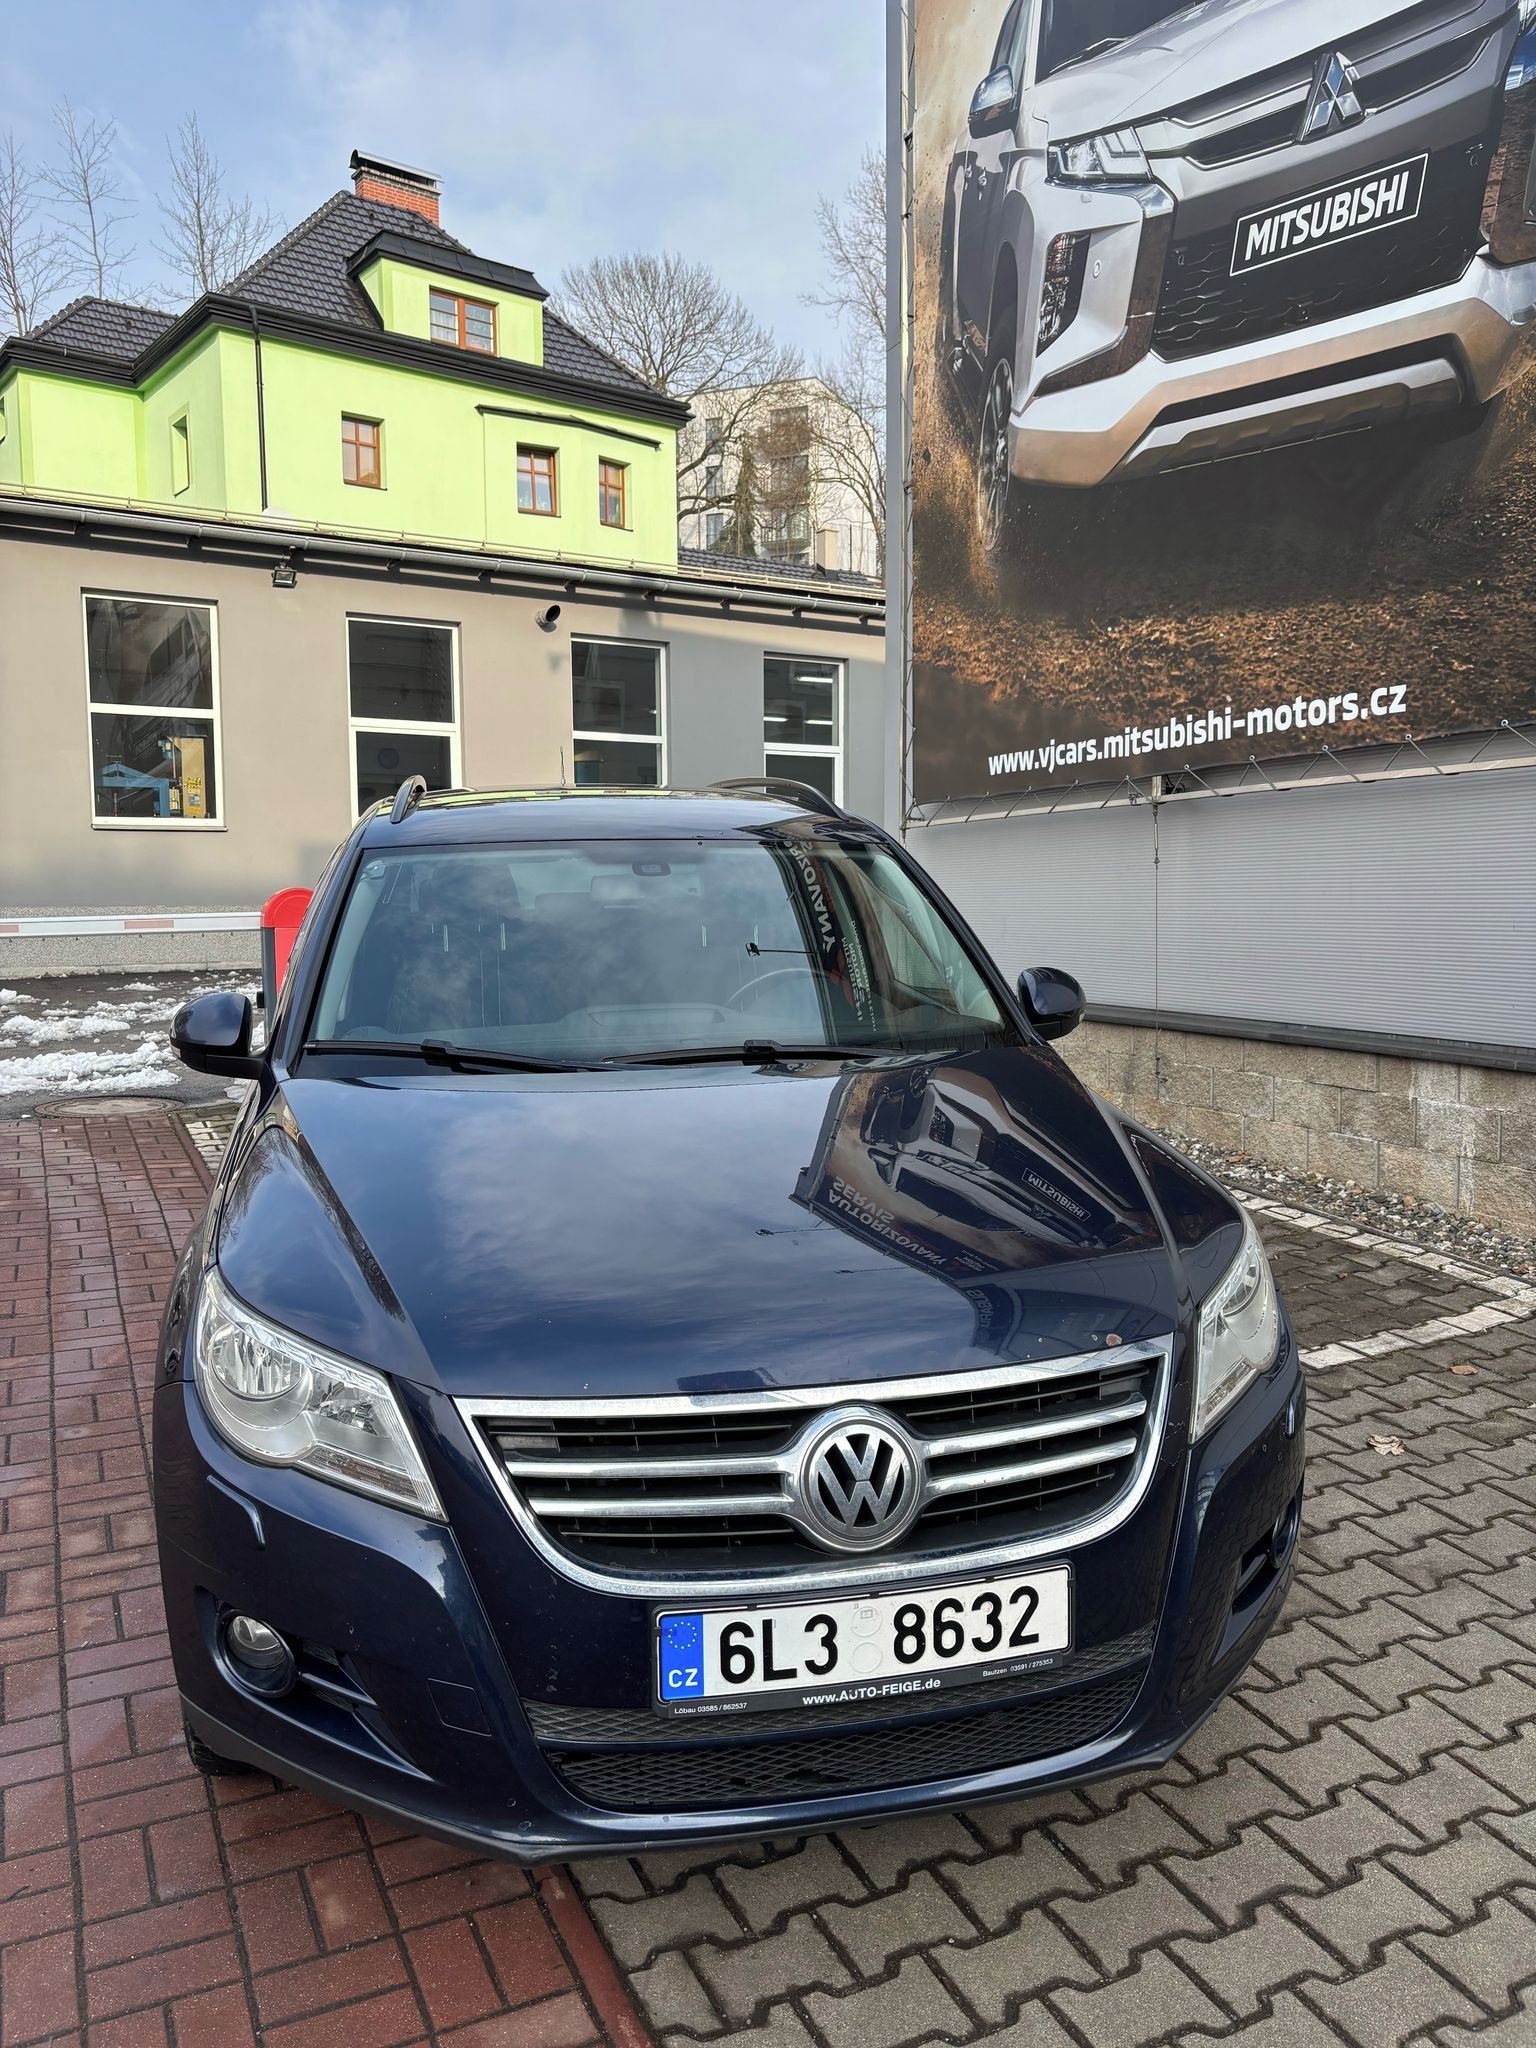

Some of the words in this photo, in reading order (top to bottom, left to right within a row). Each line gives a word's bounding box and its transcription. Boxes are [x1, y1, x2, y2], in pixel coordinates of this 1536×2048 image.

[1244, 170, 1410, 261] MITSUBISHI
[988, 684, 1408, 776] www.vjcars.mitsubishi-motors.cz
[812, 1427, 910, 1534] VW
[719, 1613, 838, 1685] 6L3
[893, 1584, 1040, 1665] 8632
[667, 1667, 698, 1689] CZ
[802, 1678, 941, 1705] www.AUTO-FEIGE.de
[982, 1668, 1008, 1677] Bautzen
[674, 1707, 696, 1715] Löbau
